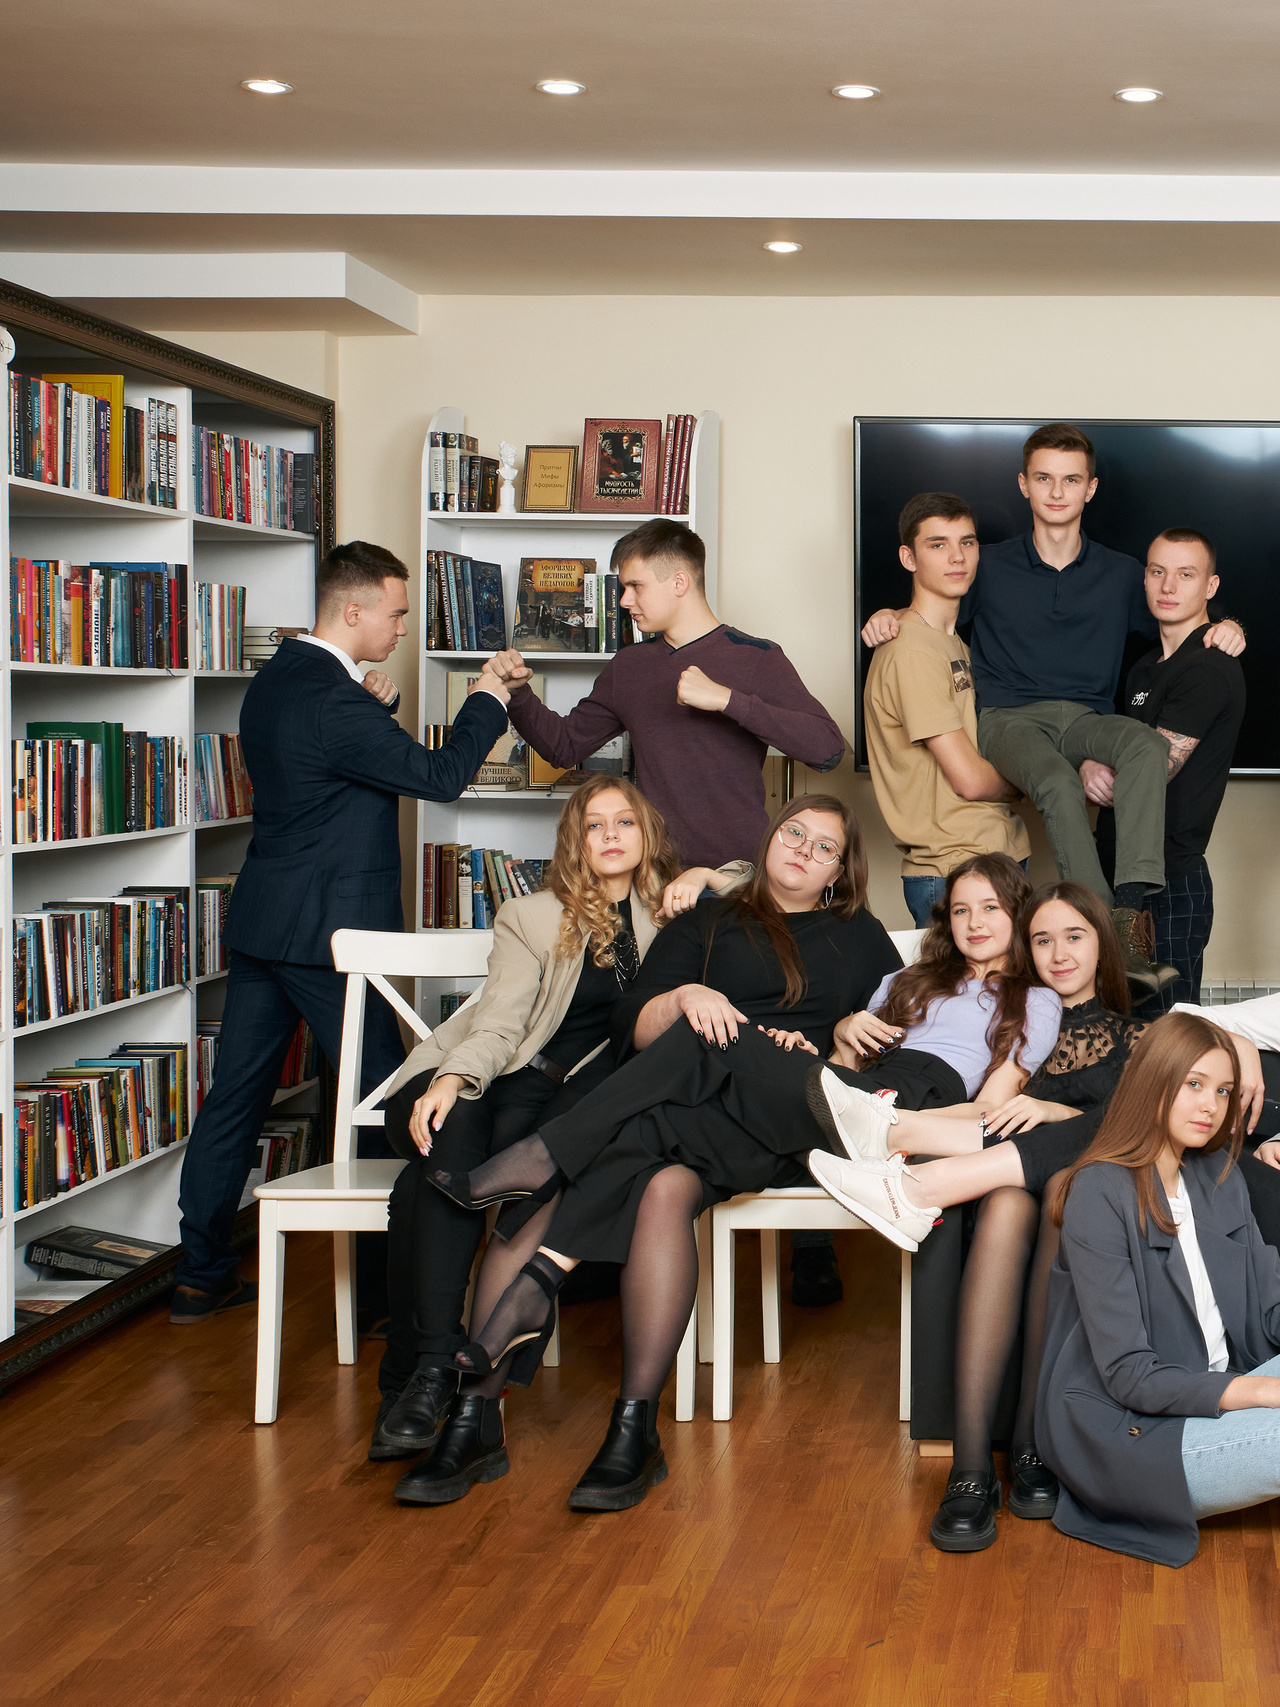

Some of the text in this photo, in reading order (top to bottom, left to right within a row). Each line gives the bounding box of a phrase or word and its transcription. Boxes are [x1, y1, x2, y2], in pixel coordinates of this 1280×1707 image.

[158, 404, 167, 433] ЖИЗНЬ
[168, 407, 177, 489] МАЛЕНЬКАЯ ЖИЗНЬ
[533, 482, 565, 490] Афоризмы
[541, 473, 560, 481] Мифы
